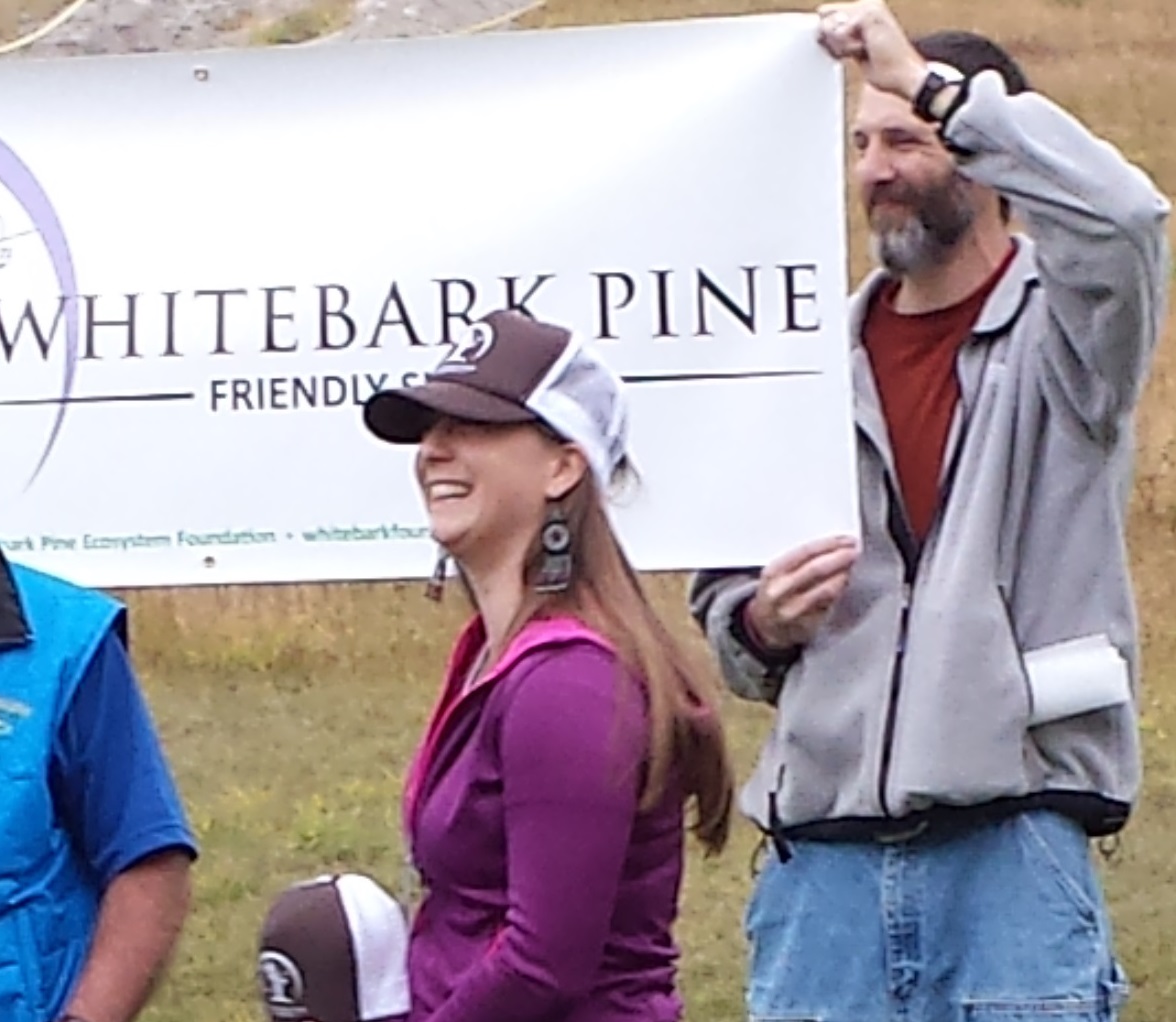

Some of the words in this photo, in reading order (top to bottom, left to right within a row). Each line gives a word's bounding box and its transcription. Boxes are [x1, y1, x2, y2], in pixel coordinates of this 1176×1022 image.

[590, 263, 821, 340] PINE
[210, 372, 389, 412] FRIENDLY
[41, 535, 76, 551] Pine
[83, 533, 171, 551] Ecosystem
[176, 529, 277, 547] Foundation
